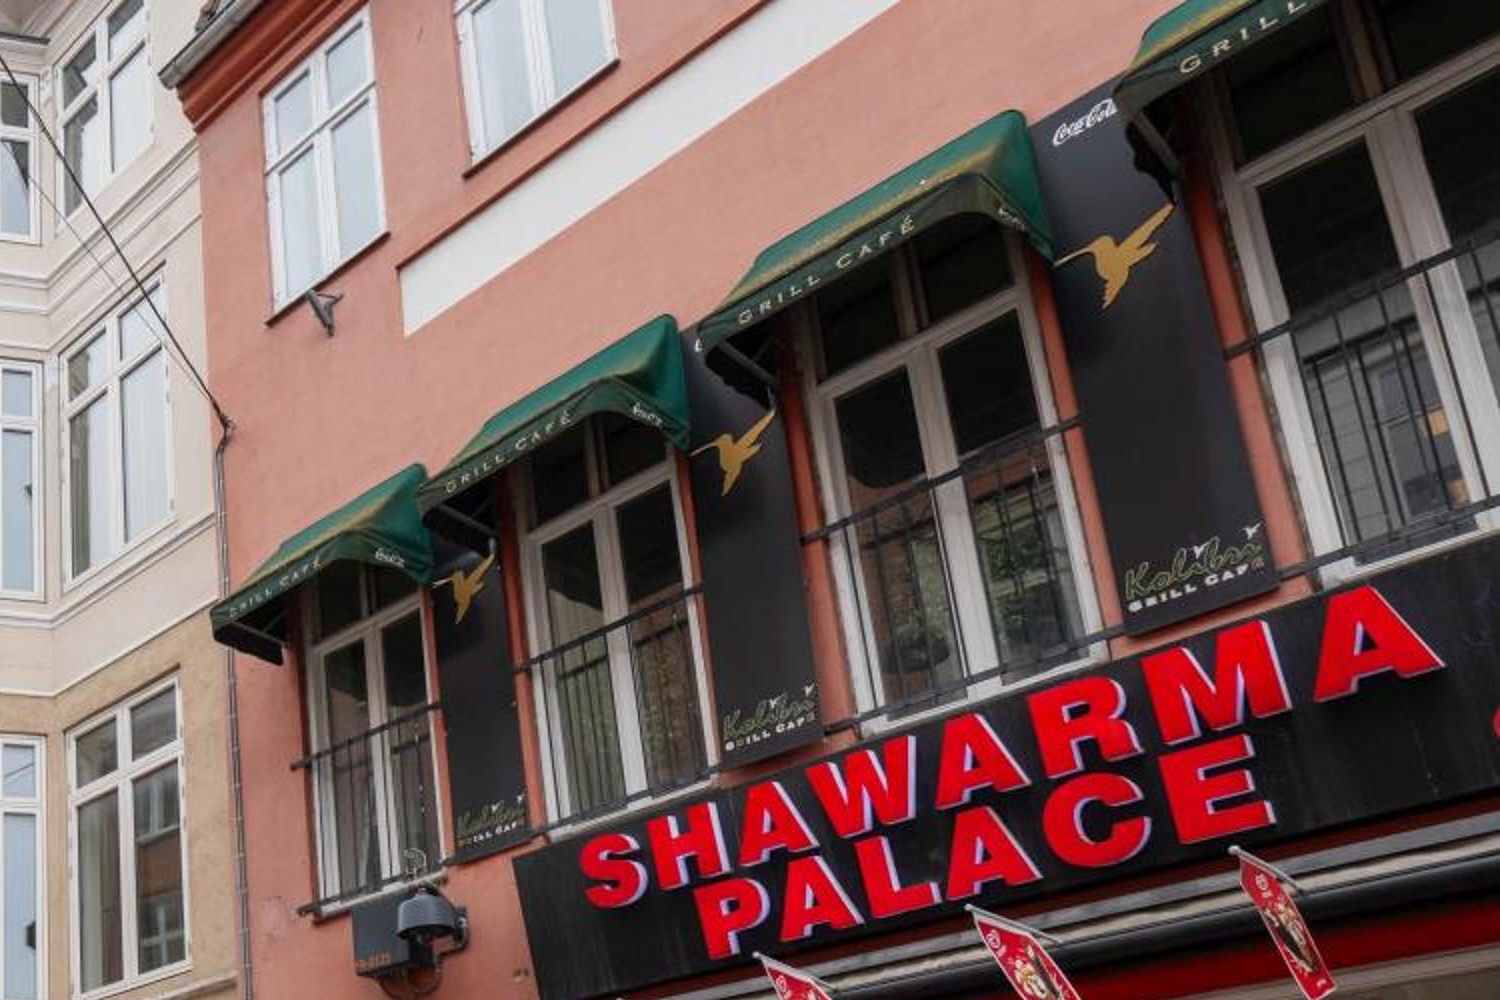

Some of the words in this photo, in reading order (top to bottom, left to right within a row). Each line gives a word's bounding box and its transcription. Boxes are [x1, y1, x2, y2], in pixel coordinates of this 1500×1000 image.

[1179, 0, 1306, 73] GRILL
[738, 275, 821, 325] GRILL
[445, 454, 506, 493] GRILL
[1128, 583, 1197, 613] GRILL
[579, 583, 1446, 909] SHAWARMA
[693, 733, 1277, 960] PALACE
